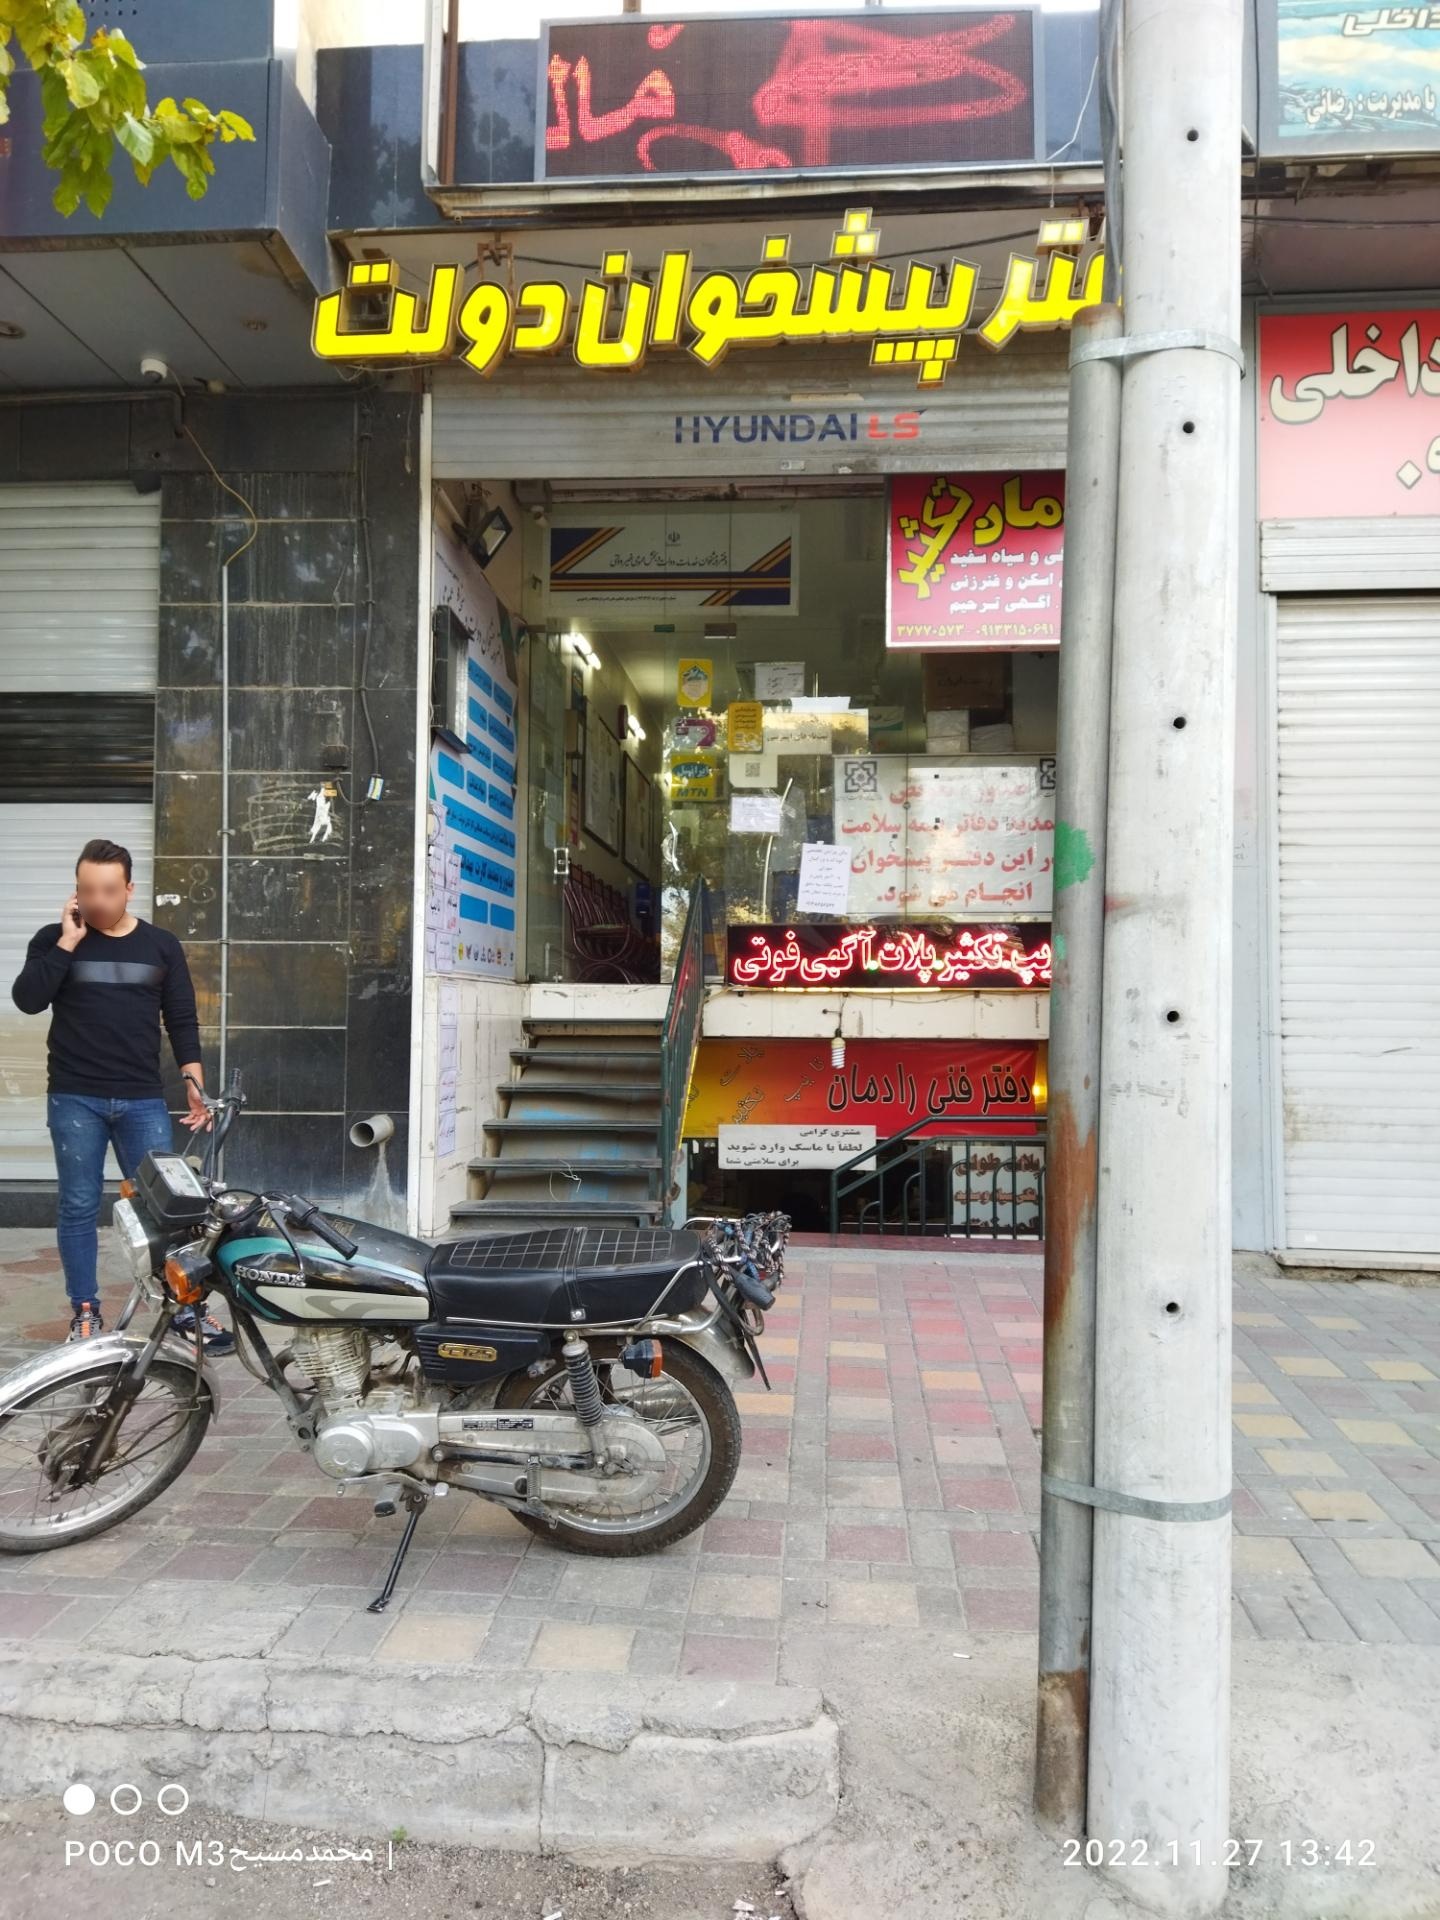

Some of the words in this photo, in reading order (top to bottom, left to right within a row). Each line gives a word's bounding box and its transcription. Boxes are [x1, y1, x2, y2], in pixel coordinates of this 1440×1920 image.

[1367, 90, 1421, 119] مدیریت
[573, 206, 981, 386] پیشخوان
[311, 257, 569, 377] دولت
[675, 413, 858, 443] HYUNDAI
[867, 409, 922, 440] LS
[950, 549, 987, 567] سفید
[992, 548, 1024, 566] سیاه
[1018, 573, 1053, 589] اسکن
[950, 597, 1000, 614] ترحیم
[676, 786, 708, 798] MTN
[841, 814, 902, 834] سلامت
[1004, 815, 1055, 836] مدید
[851, 848, 932, 874] پیشخوان
[1002, 846, 1033, 873] این
[964, 881, 1033, 907] انجام
[733, 931, 801, 983] فوتی
[827, 1063, 917, 1115] رادمان
[927, 1064, 973, 1115] فنی
[980, 1063, 1032, 1115] دفتر
[800, 1128, 828, 1137] گرامی
[831, 1128, 861, 1137] مشتری
[727, 1142, 756, 1153] شوید
[760, 1143, 785, 1154] وارد
[789, 1142, 823, 1152] ماسک
[827, 1143, 834, 1154] با
[726, 1157, 741, 1165] شما
[743, 1157, 776, 1167] سلامتی
[778, 1157, 799, 1167] برای
[234, 1264, 306, 1287] HONDA
